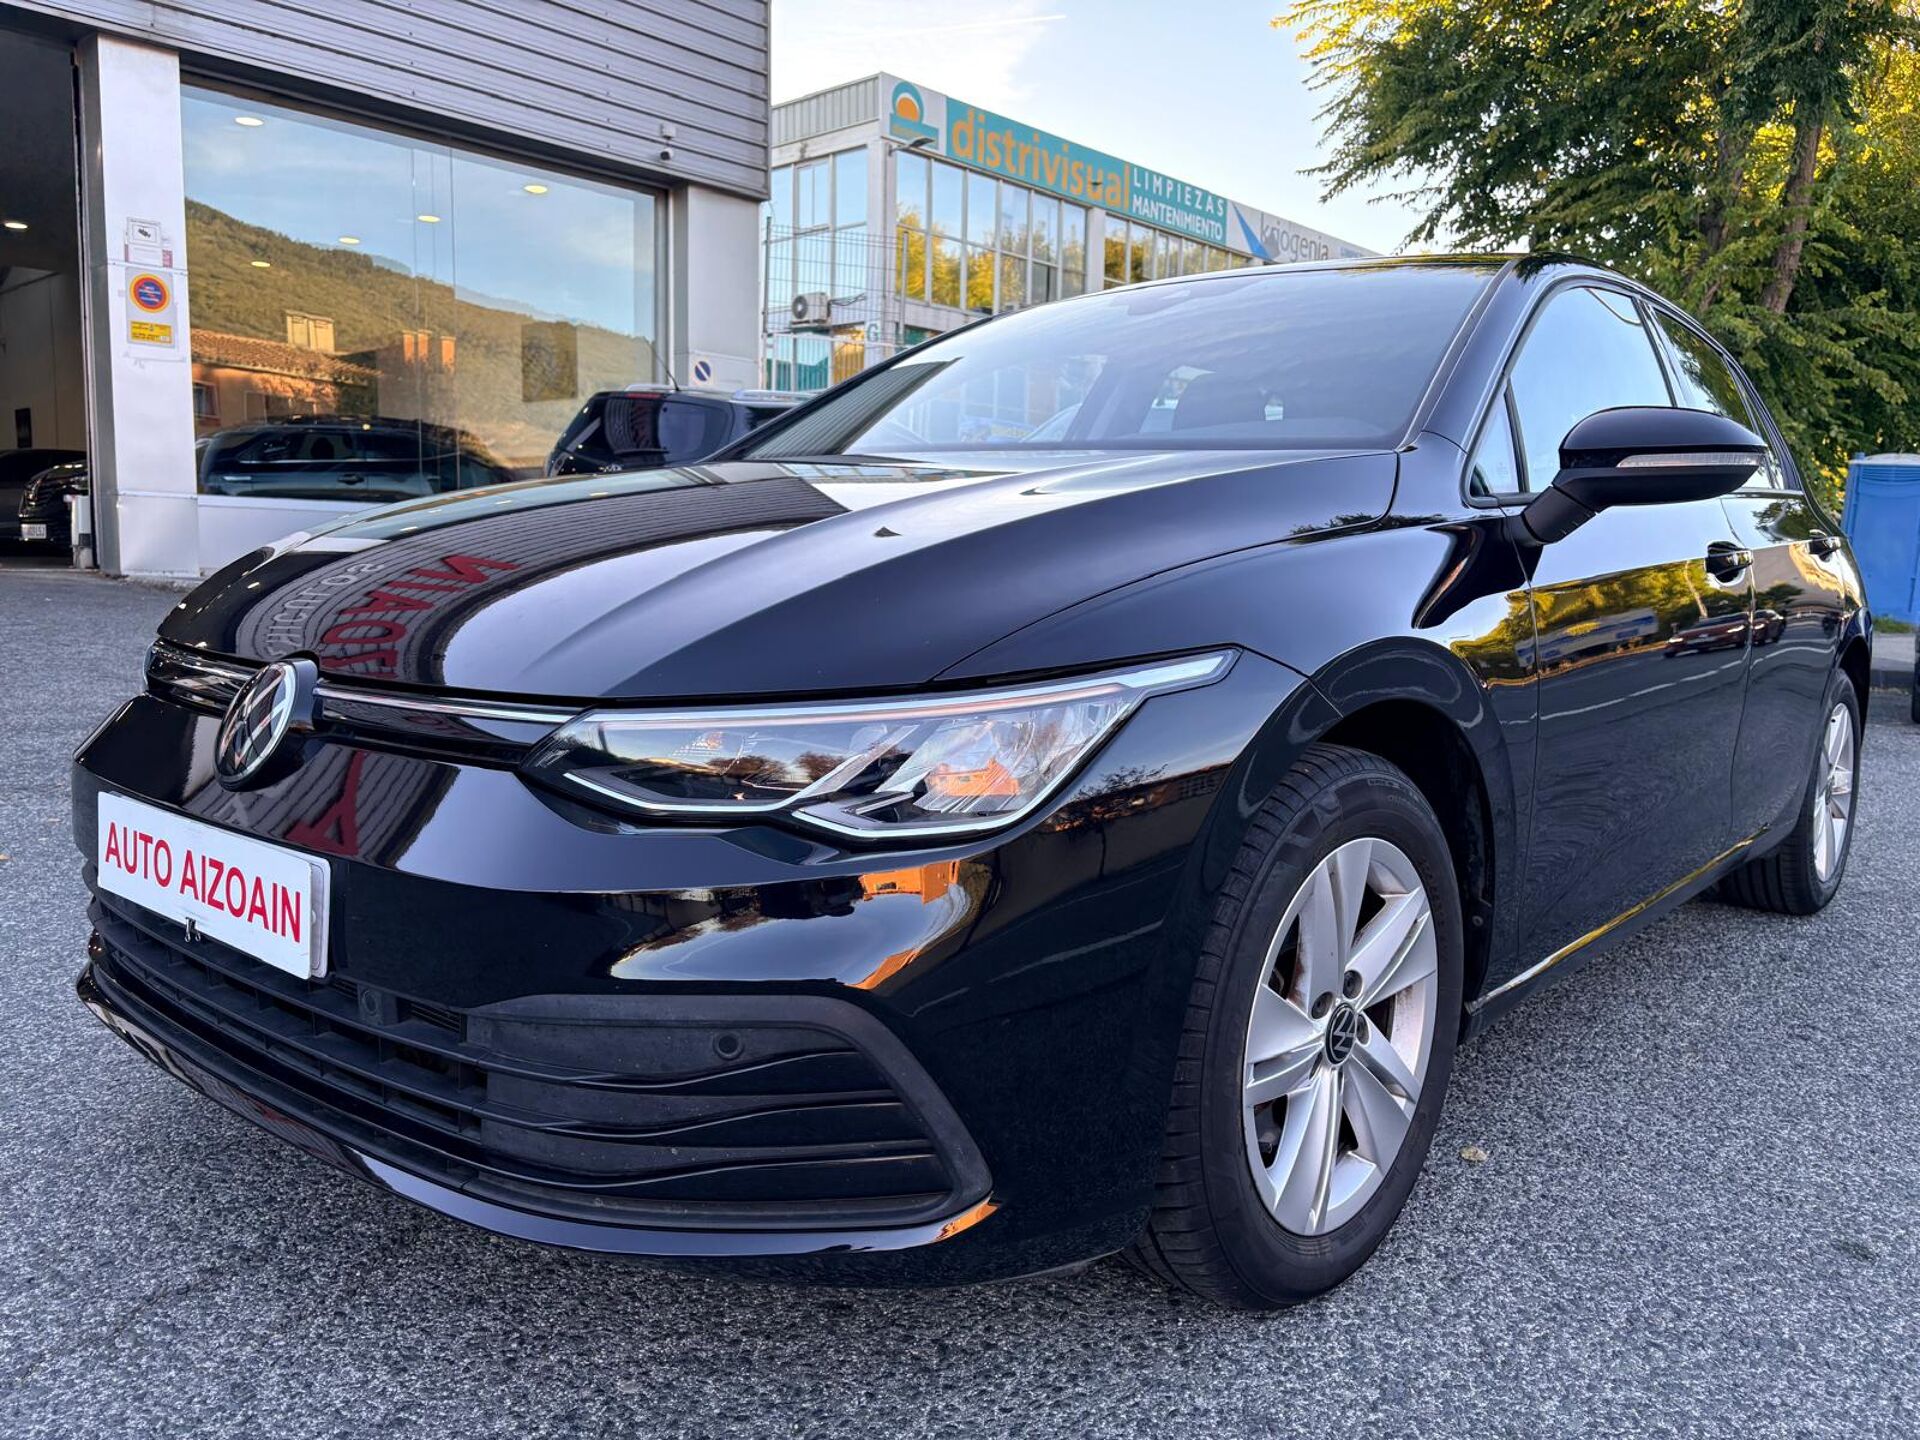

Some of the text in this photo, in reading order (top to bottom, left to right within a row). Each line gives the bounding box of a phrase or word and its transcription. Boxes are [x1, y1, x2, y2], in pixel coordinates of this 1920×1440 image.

[952, 107, 1130, 212] distrivisual
[1133, 167, 1224, 217] LIMPIEZAS
[1132, 194, 1223, 240] MANTENIMIENTO
[105, 821, 301, 943] AUTO AIZOAIN
